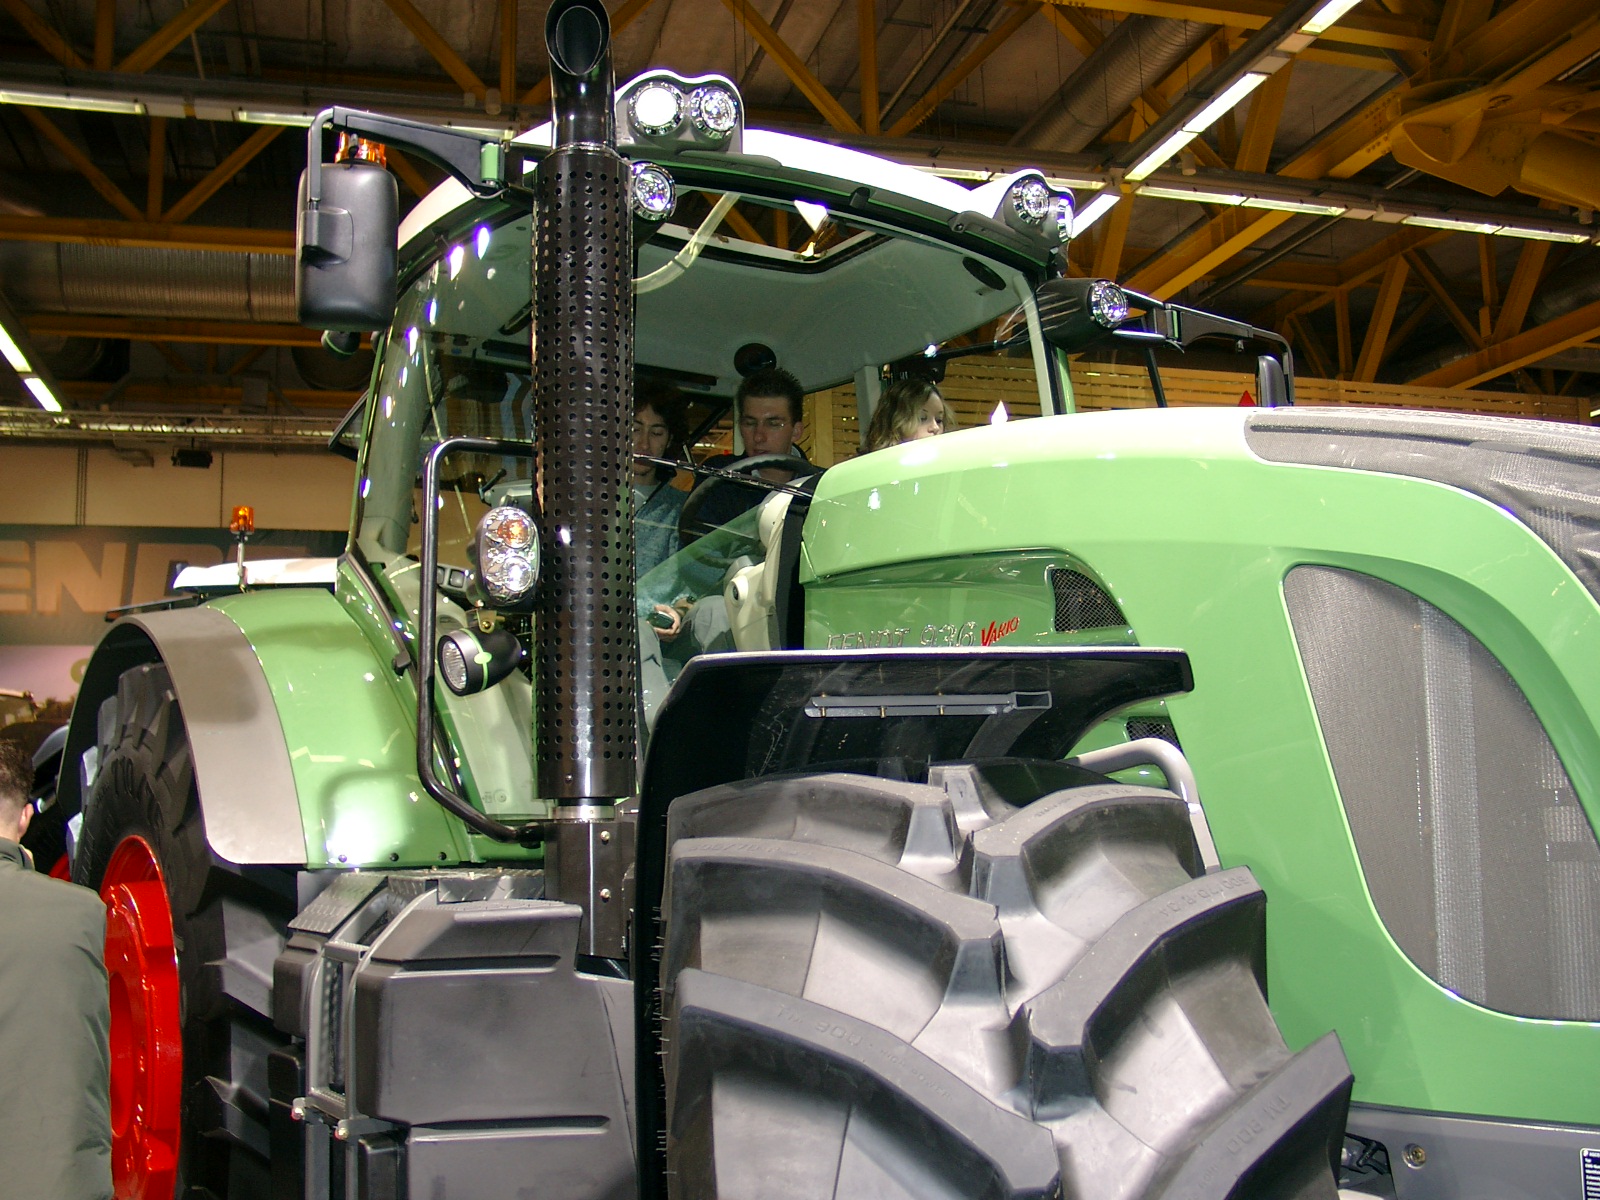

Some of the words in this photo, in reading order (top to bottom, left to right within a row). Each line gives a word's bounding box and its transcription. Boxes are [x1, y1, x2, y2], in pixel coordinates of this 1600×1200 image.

[826, 627, 910, 650] FENDT
[919, 621, 977, 648] 936
[980, 616, 1020, 647] VARIO
